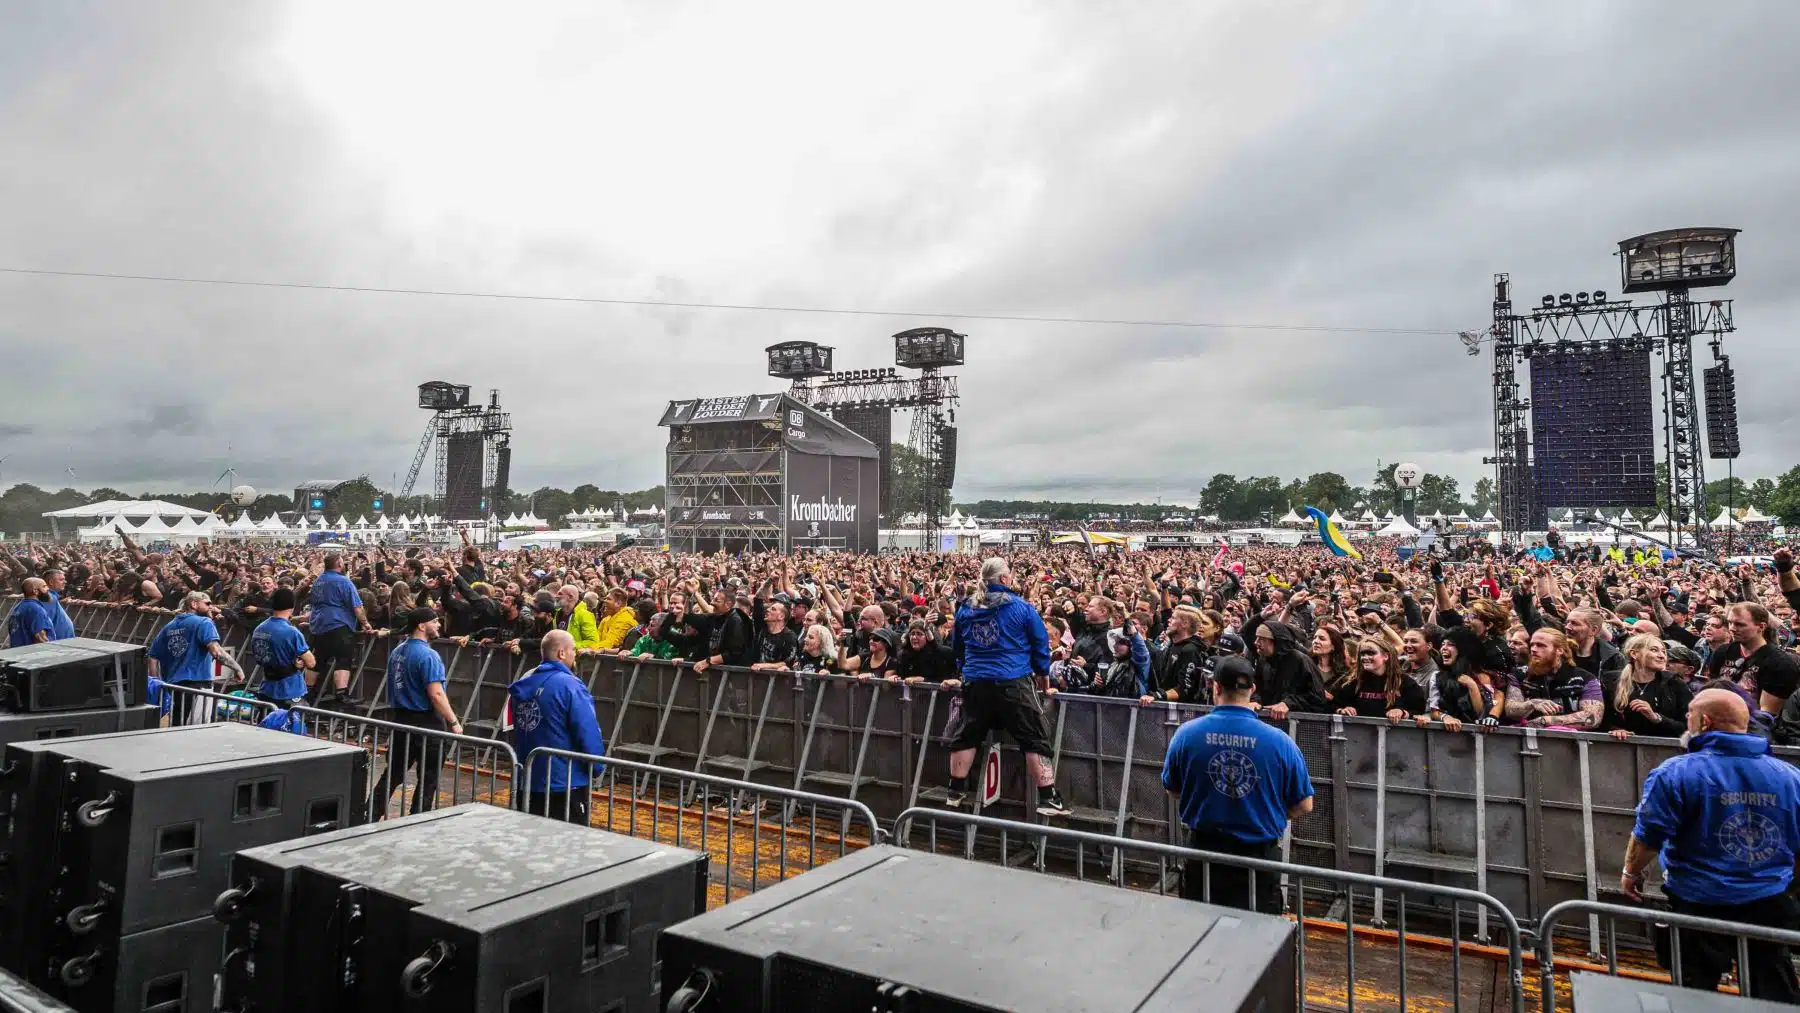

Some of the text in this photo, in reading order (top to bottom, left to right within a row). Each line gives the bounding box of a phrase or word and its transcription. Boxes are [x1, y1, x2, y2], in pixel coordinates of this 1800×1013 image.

[697, 402, 746, 412] HARDER
[701, 396, 749, 405] FASTER
[692, 409, 743, 420] LOUDER
[791, 412, 802, 425] DB
[788, 427, 806, 439] Cargo
[791, 494, 857, 522] Krombacher
[1205, 732, 1257, 749] SECURITY
[986, 752, 998, 800] D
[1720, 791, 1777, 806] SECURITY
